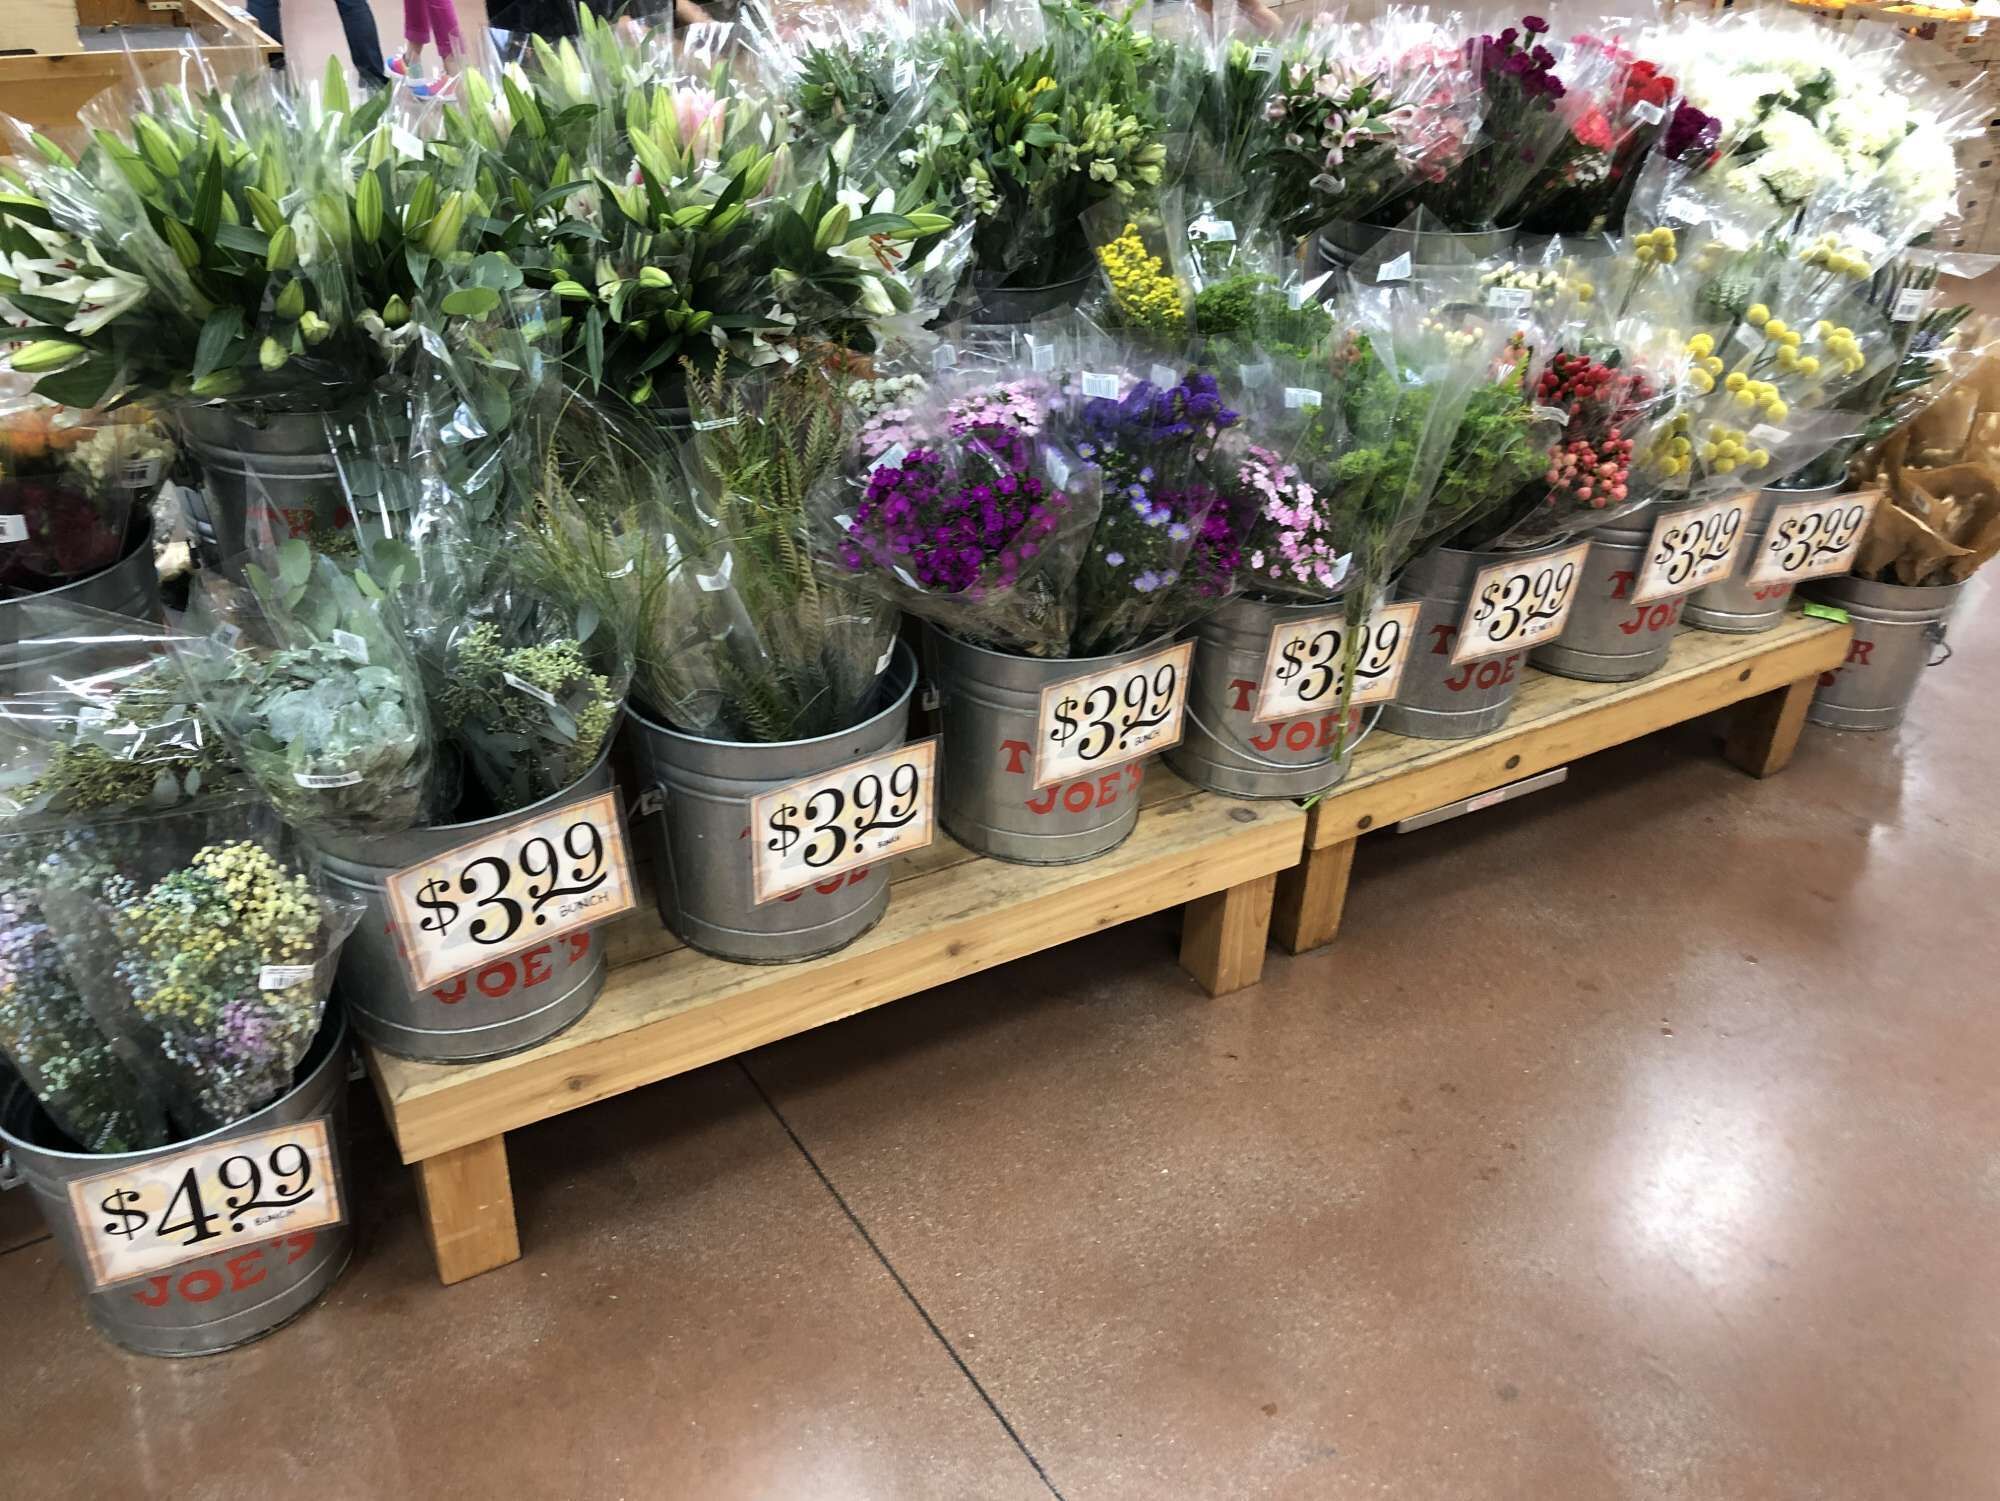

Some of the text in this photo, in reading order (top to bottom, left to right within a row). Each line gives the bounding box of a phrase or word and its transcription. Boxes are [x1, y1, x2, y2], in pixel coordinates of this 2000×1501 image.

[1655, 508, 1741, 585] $3.99
[1770, 505, 1864, 572] $3.99
[1474, 562, 1574, 642] $3.99
[1050, 663, 1176, 760] $3.99
[768, 763, 919, 868] $3.99
[416, 821, 607, 944] $3.99
[559, 891, 610, 918] BUNCH
[101, 1143, 314, 1247] $4.99
